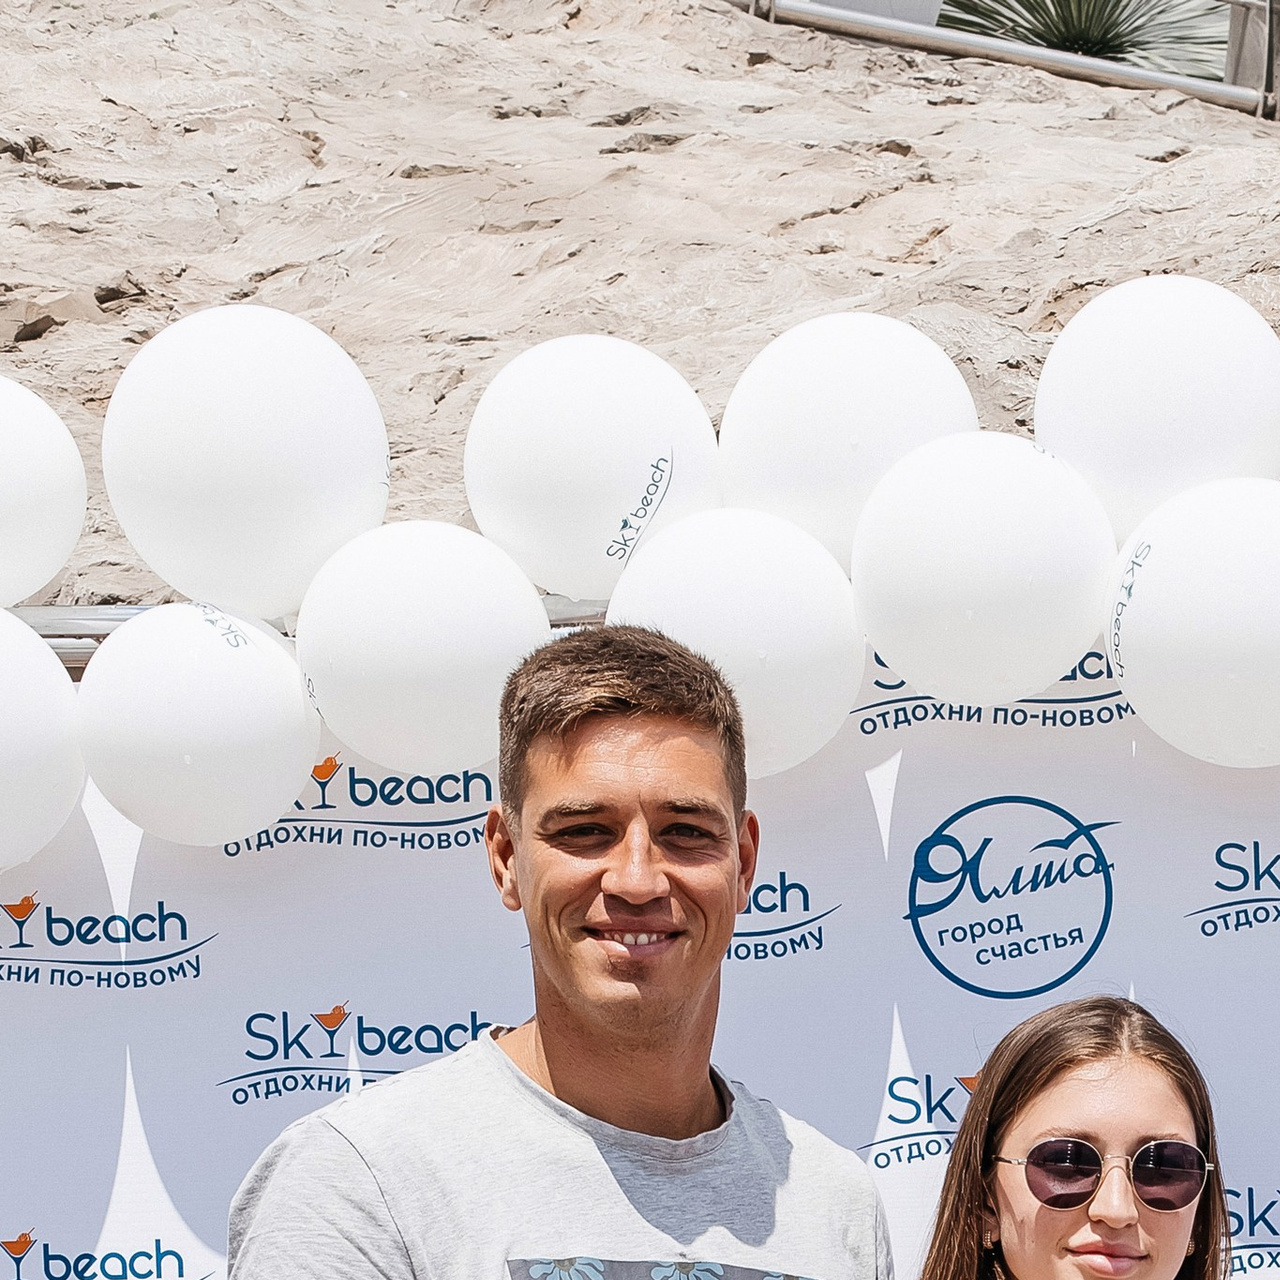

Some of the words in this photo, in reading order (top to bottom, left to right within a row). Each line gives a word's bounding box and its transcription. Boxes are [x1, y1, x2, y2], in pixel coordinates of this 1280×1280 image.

[630, 457, 668, 519] beach
[993, 702, 1135, 728] по-новом
[348, 767, 493, 807] beach
[352, 828, 486, 850] по-новом
[45, 900, 188, 947] beach
[937, 913, 1024, 947] город
[975, 927, 1084, 966] счастья
